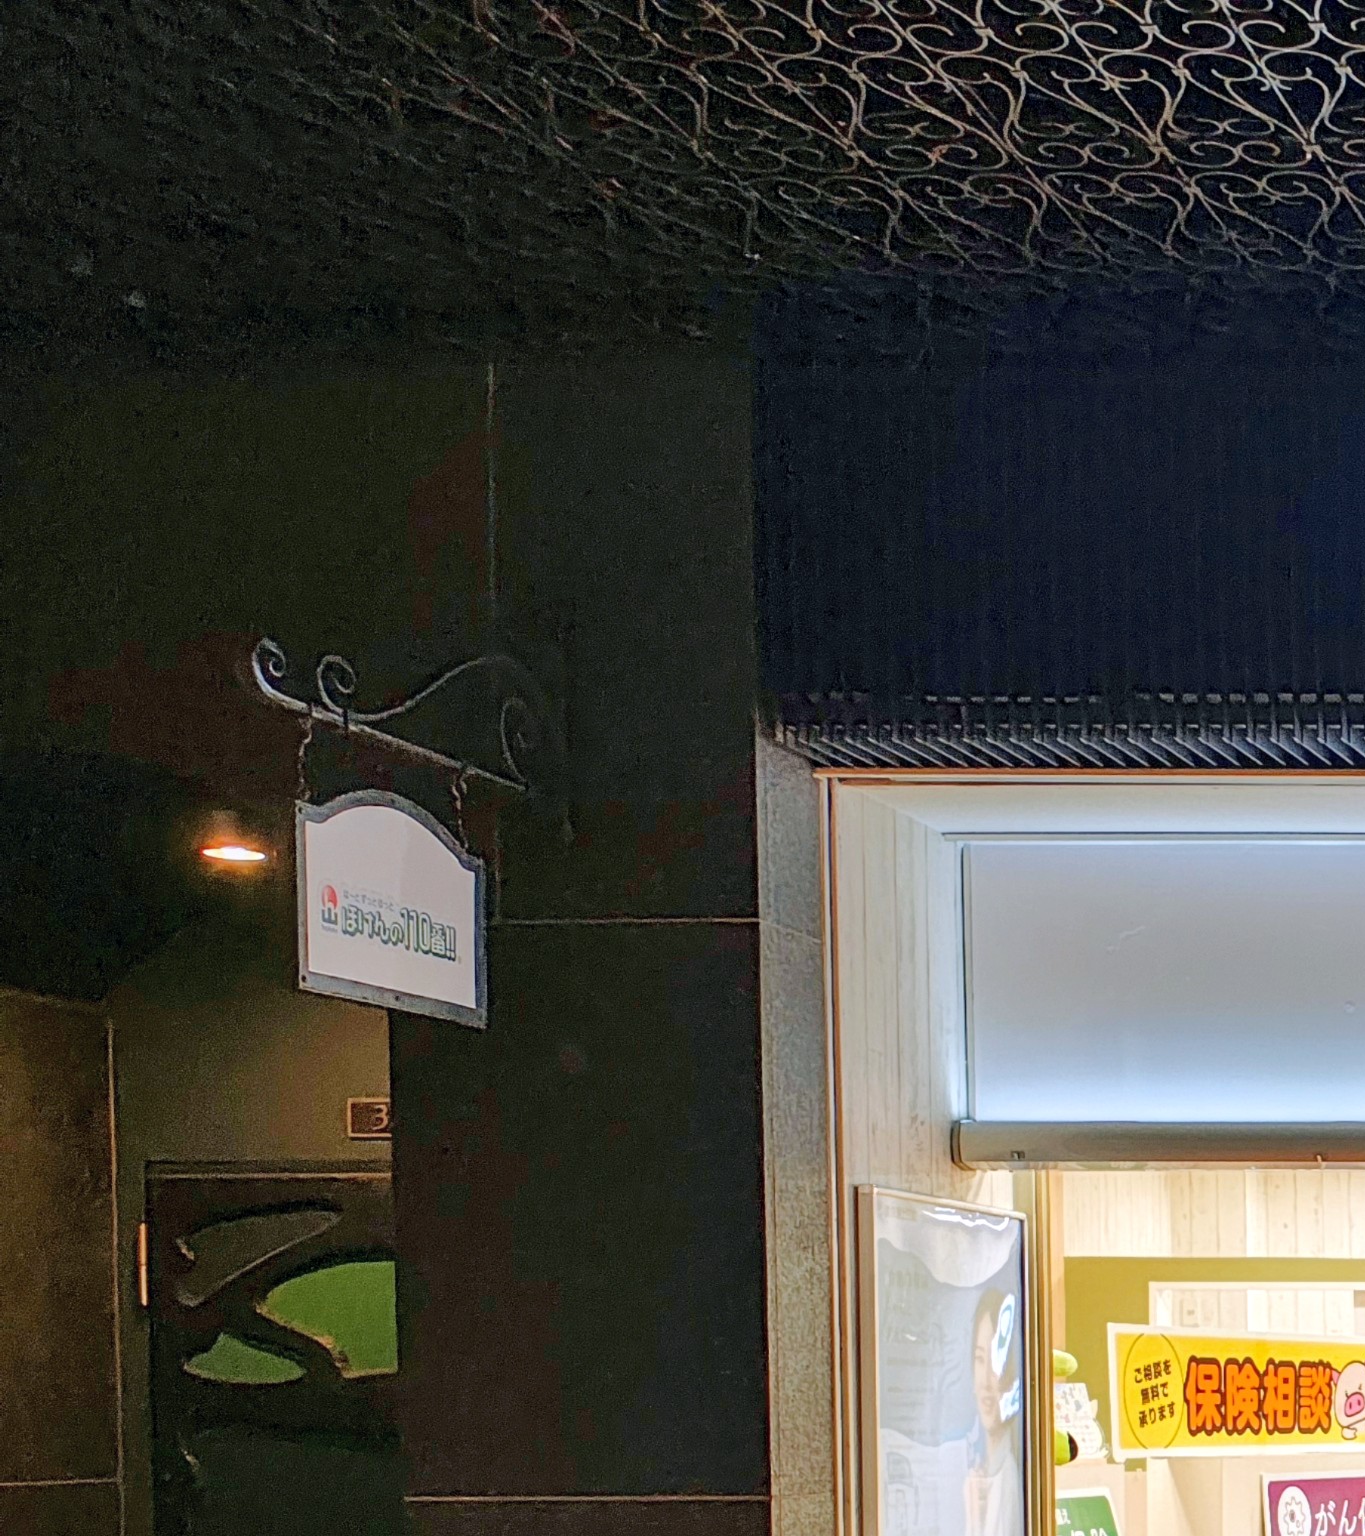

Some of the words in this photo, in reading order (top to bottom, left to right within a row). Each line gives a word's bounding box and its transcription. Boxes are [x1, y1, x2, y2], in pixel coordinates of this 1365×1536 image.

[1133, 1359, 1173, 1385] ご相談を
[1140, 1381, 1169, 1406] 無料で
[1184, 1354, 1335, 1437] 保険相談
[1138, 1402, 1176, 1428] 承ります
